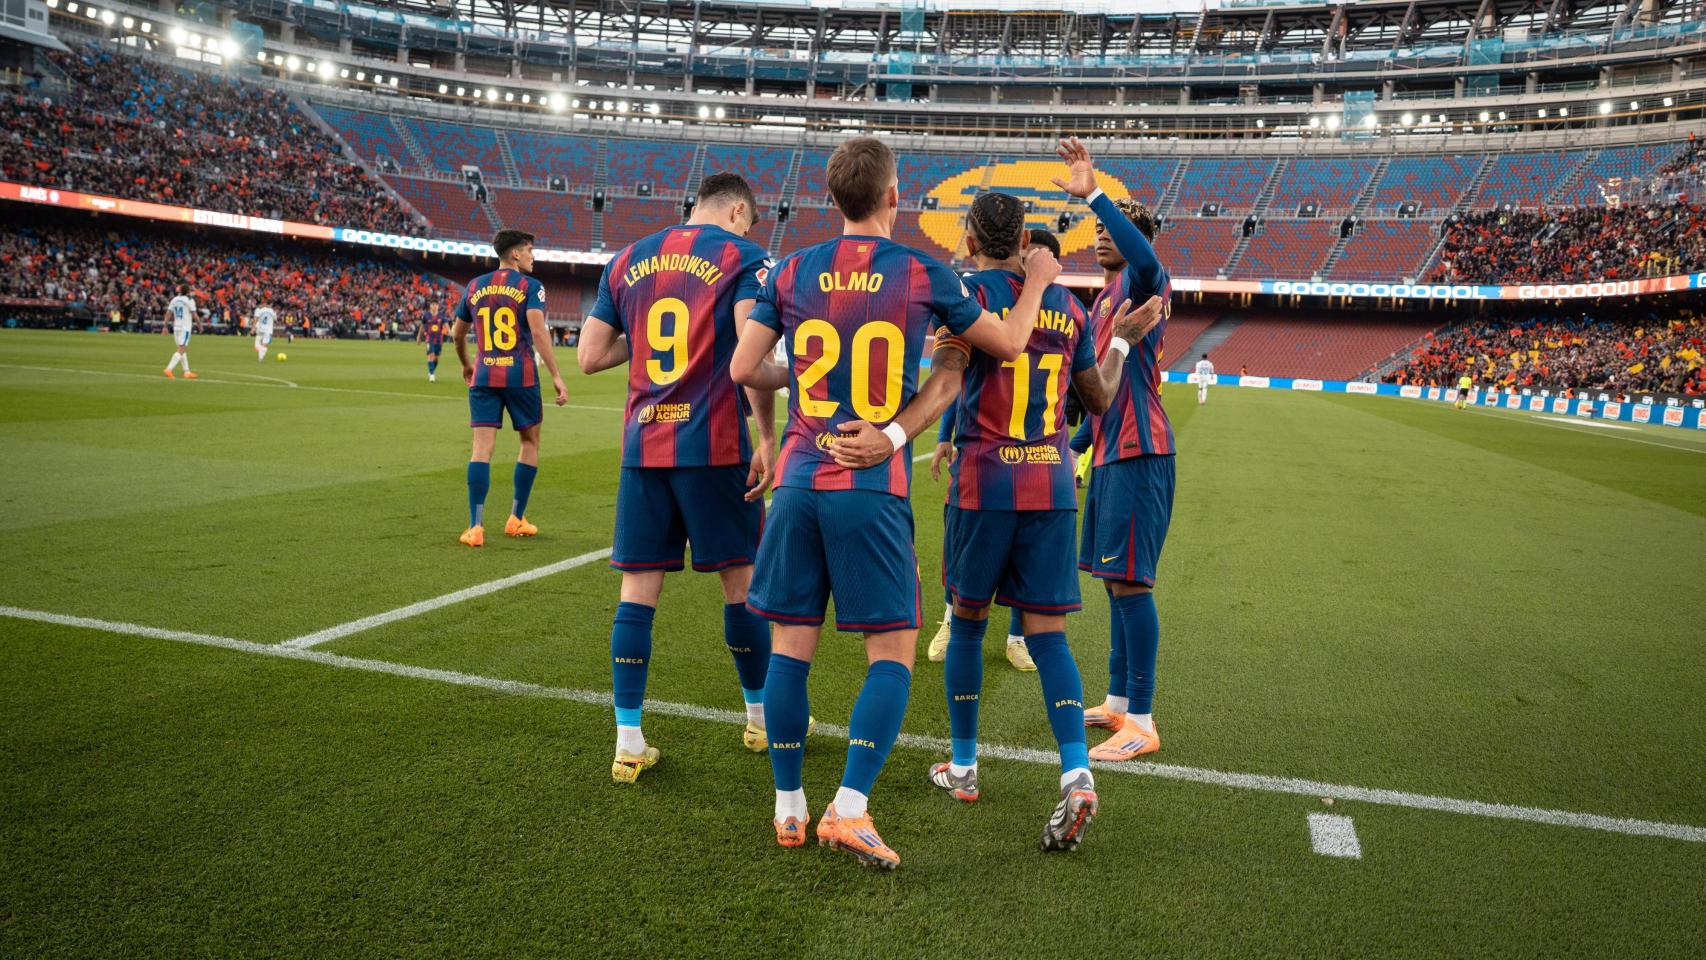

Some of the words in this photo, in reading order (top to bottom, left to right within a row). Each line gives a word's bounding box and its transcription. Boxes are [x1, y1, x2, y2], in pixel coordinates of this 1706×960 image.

[623, 253, 724, 288] LEWANDOWSKI
[818, 271, 884, 293] OLMO
[476, 306, 517, 352] 18
[646, 297, 690, 386] 9
[793, 318, 905, 423] 20
[656, 403, 691, 412] UNHCR
[1001, 352, 1064, 441] 11
[656, 410, 690, 420] ACNUR
[1025, 444, 1059, 454] UNHCR
[1026, 452, 1062, 461] ACNUR
